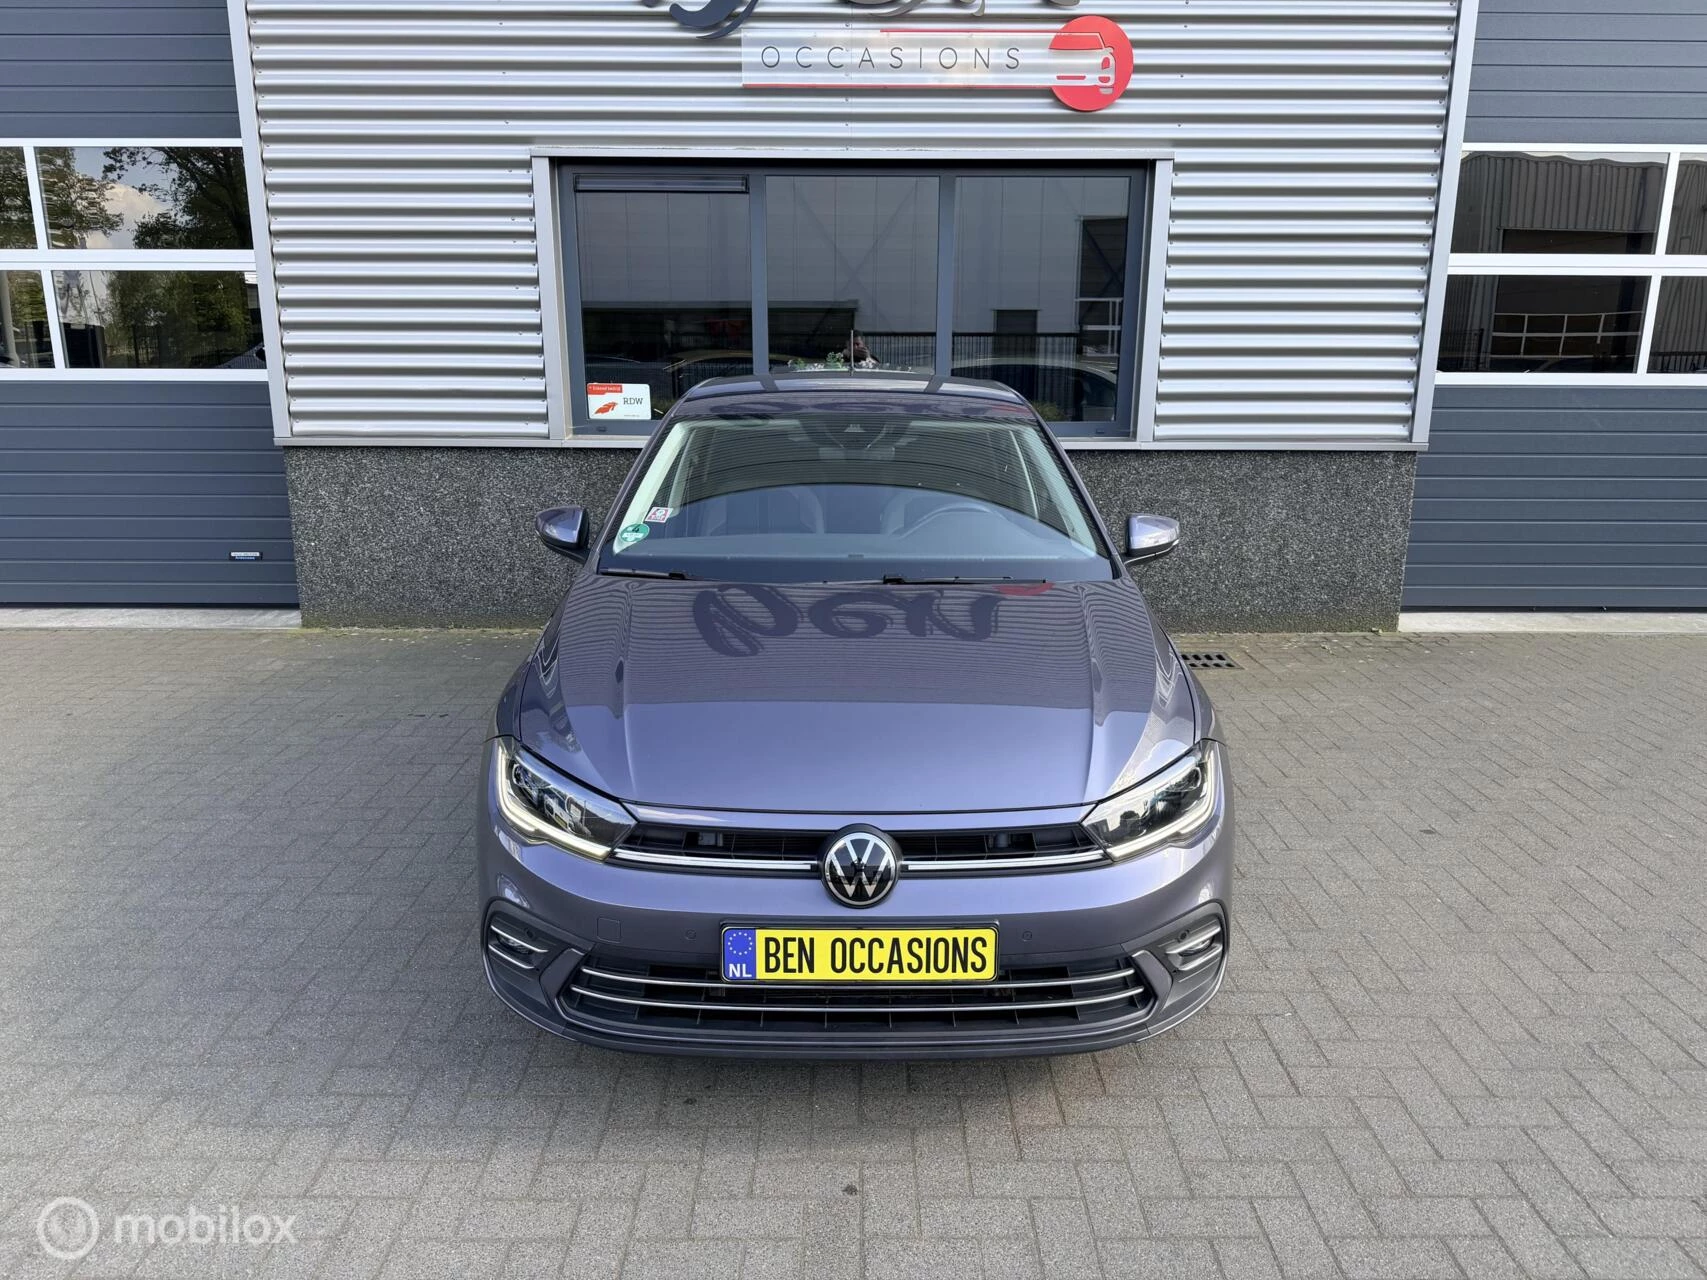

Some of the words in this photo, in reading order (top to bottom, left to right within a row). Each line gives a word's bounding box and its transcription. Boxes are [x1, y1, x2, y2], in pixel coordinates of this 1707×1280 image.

[760, 46, 1020, 70] OCCASIONS
[623, 397, 643, 405] RDW
[764, 937, 815, 974] BEN
[830, 937, 987, 974] OCCASIONS
[728, 963, 752, 978] NL
